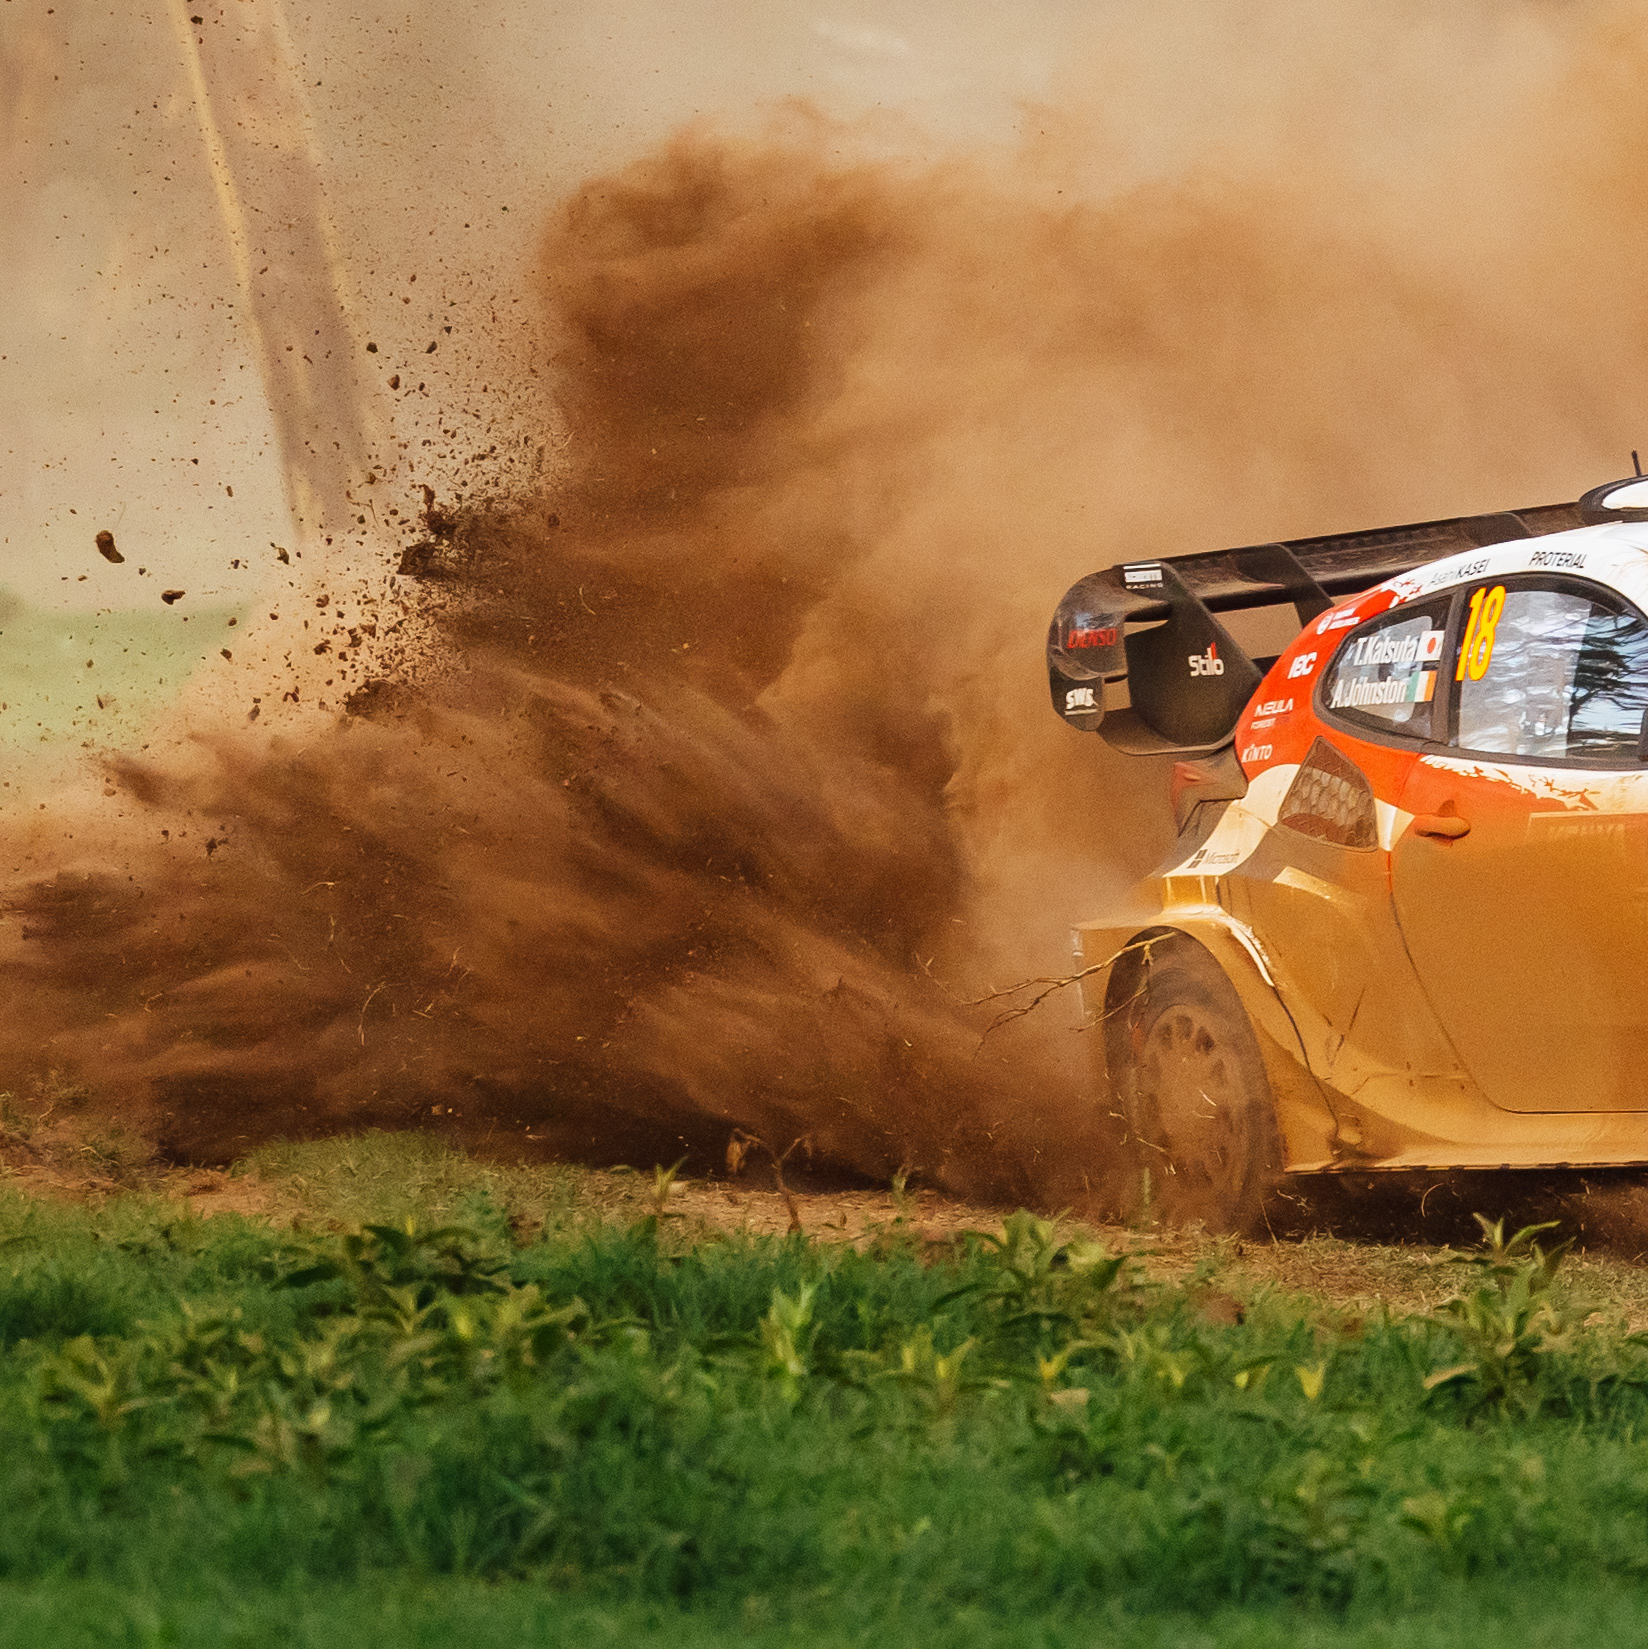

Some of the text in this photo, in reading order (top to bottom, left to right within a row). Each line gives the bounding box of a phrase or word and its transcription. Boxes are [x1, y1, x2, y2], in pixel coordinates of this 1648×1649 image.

[1528, 551, 1588, 569] PROTERIAL
[1067, 627, 1118, 649] DENSO
[1455, 585, 1506, 681] 18
[1188, 642, 1225, 677] Stilo
[1353, 634, 1419, 667] T.Katsuta
[1329, 675, 1407, 710] A.Johnston
